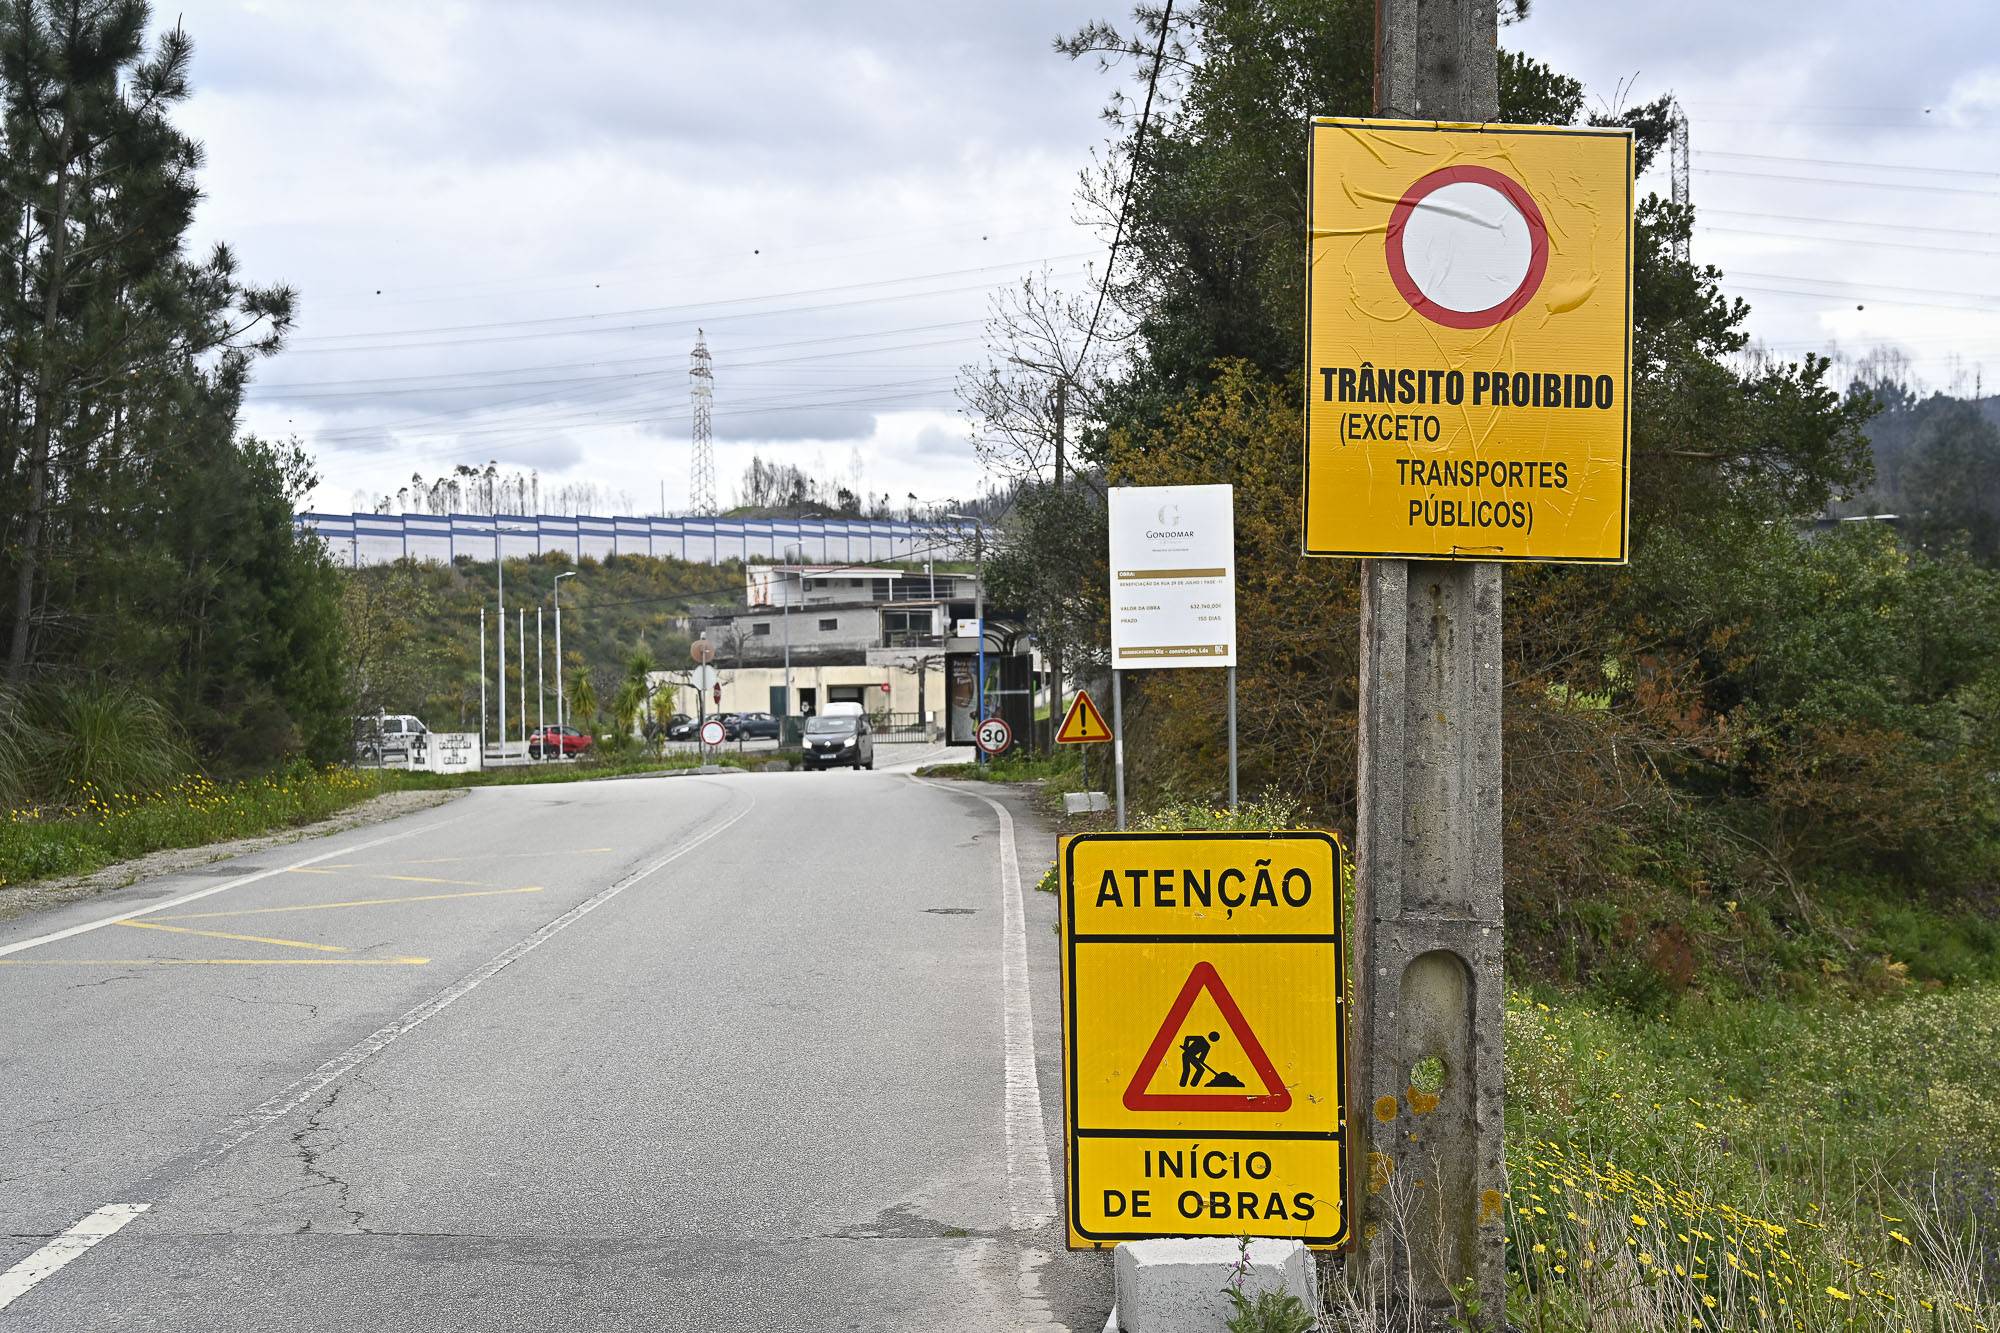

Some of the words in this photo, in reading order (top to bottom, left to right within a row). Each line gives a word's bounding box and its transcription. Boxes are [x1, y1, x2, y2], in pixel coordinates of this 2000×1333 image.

[1320, 362, 1464, 405] TRÂNSITO
[1472, 371, 1614, 409] PROIBIDO
[1340, 412, 1441, 446] (EXCETO
[1396, 459, 1568, 488] TRANSPORTES
[1409, 493, 1533, 535] PÚBLICOS)
[982, 729, 1005, 743] 30
[1096, 858, 1312, 920] ATENÇÃO
[1144, 1143, 1272, 1180] INÍCIO
[1104, 1189, 1152, 1218] DE
[1177, 1190, 1316, 1221] OBRAS
